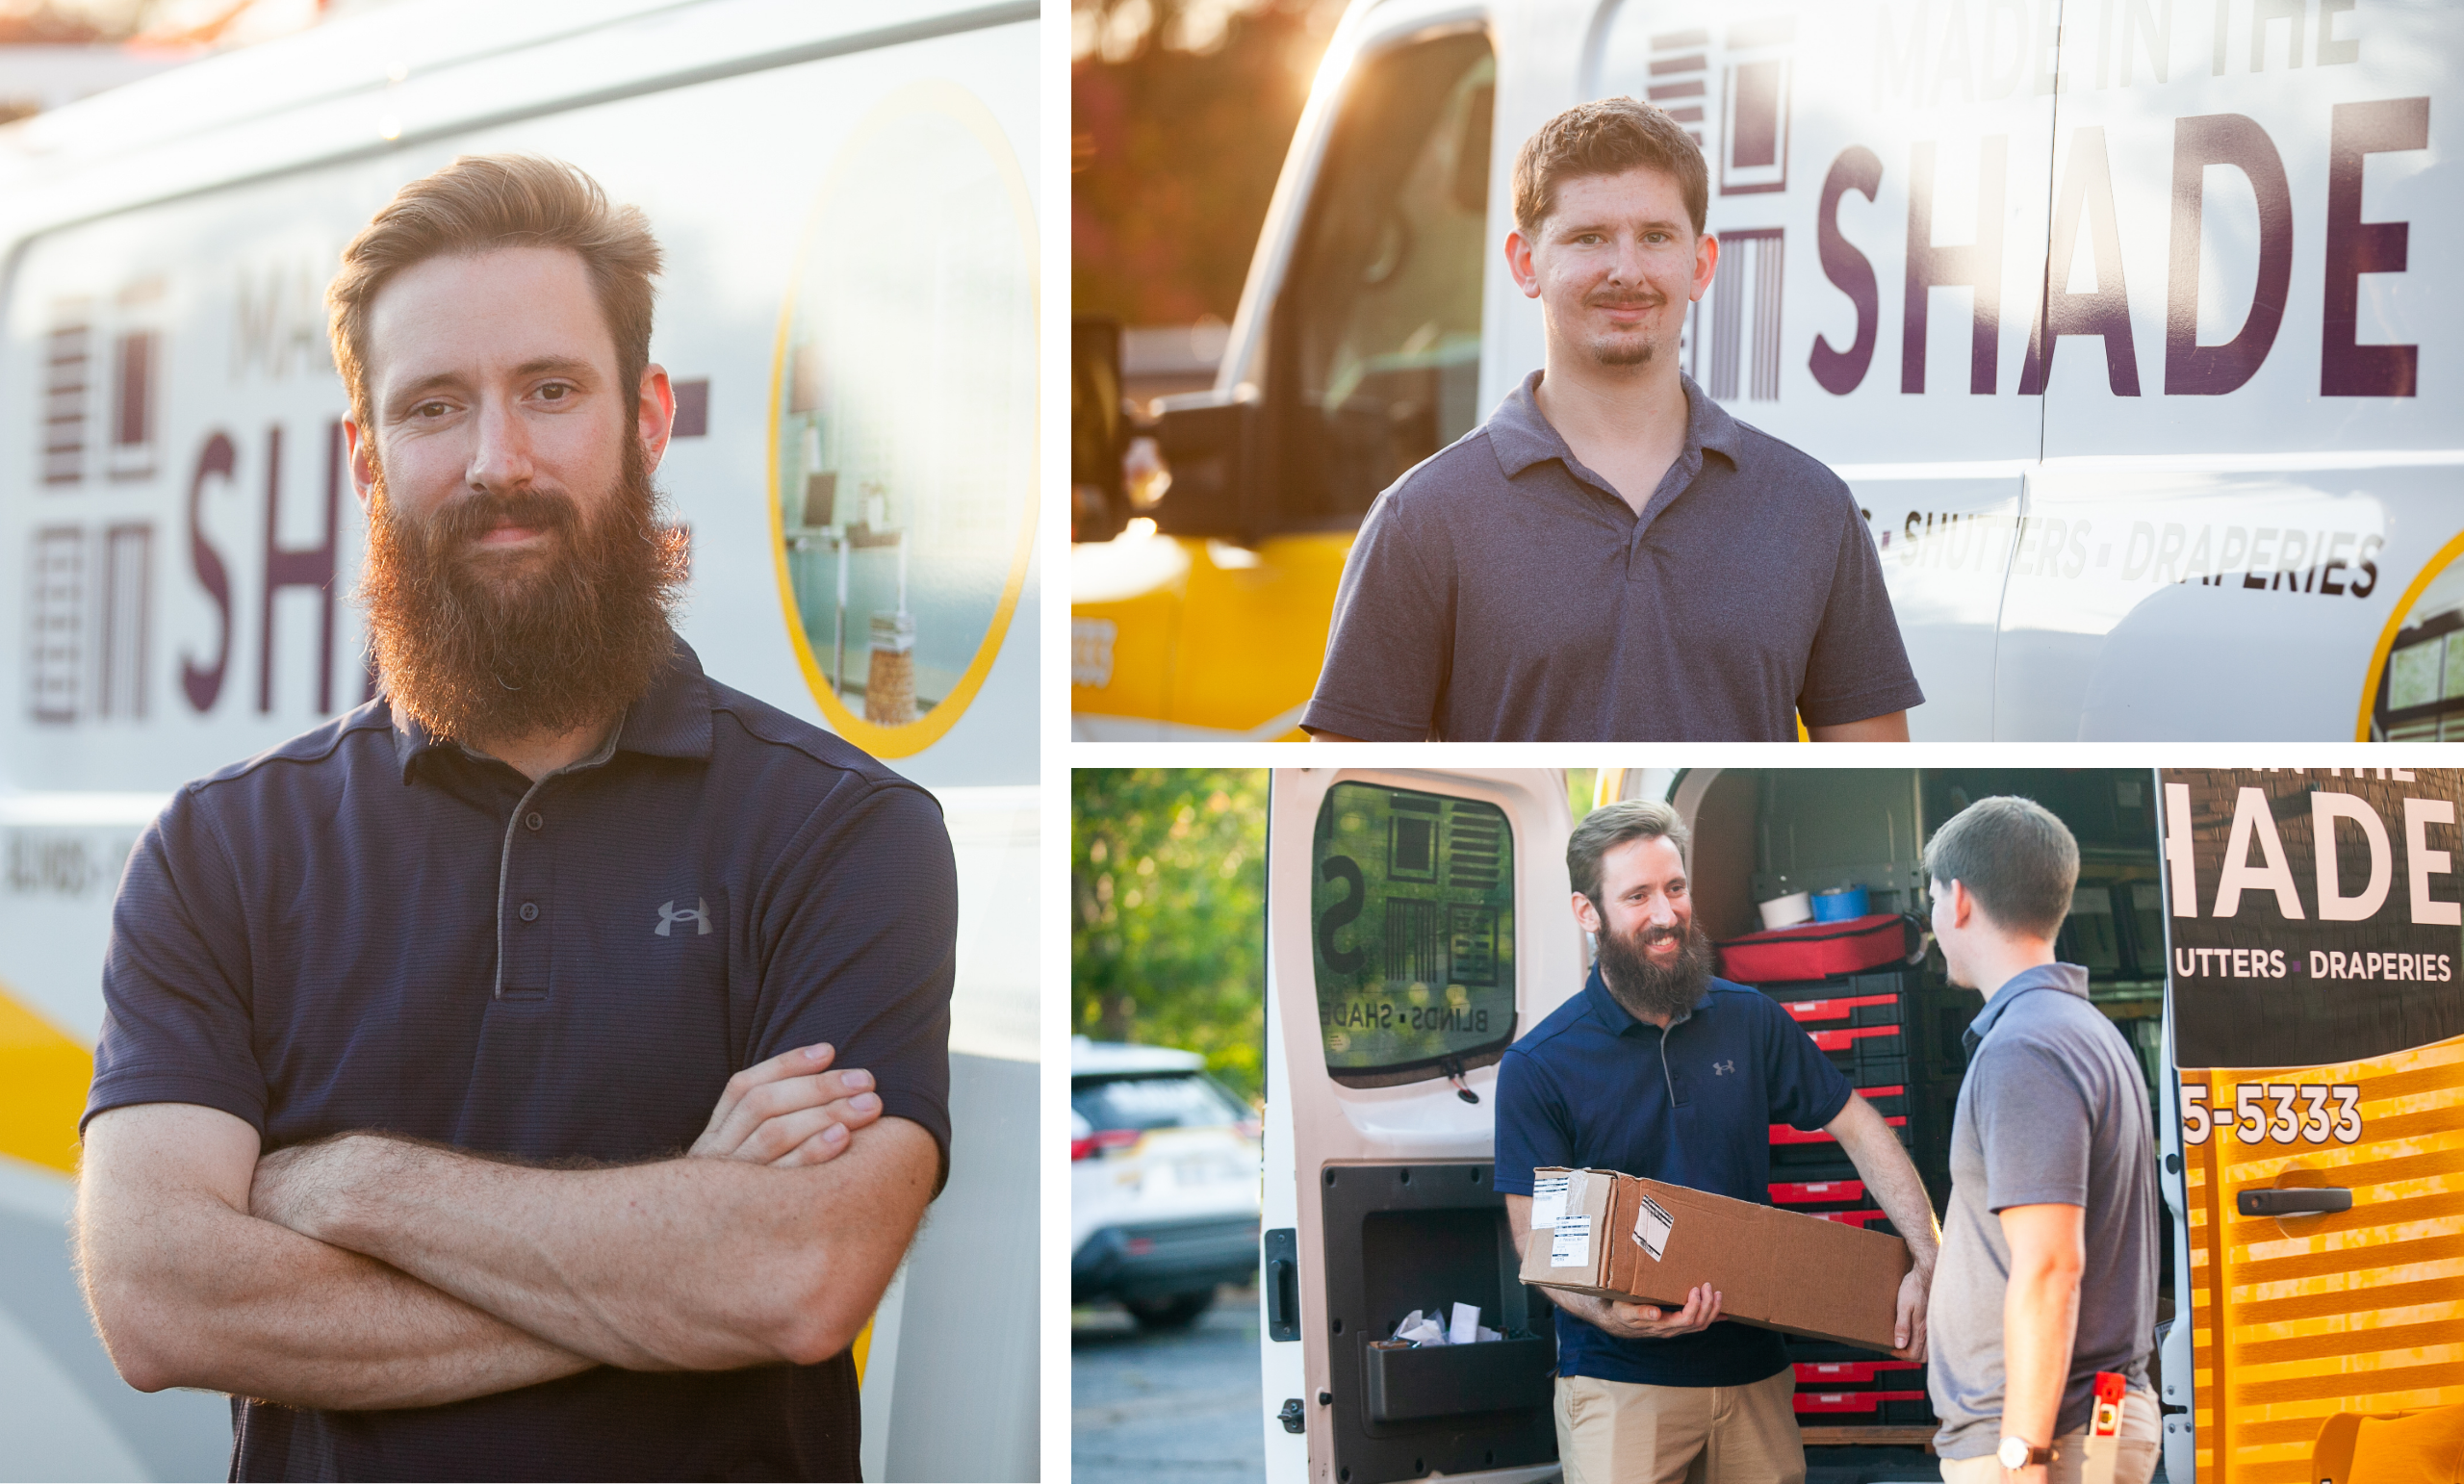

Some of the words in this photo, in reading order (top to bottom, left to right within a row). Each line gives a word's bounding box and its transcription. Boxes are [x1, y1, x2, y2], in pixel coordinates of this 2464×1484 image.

[2095, 0, 2172, 90] IN
[1808, 96, 2430, 397] SHADE
[1900, 509, 2092, 579] SHUTTERS
[2121, 521, 2386, 599] DRAPERIES
[2310, 950, 2451, 982] DRAPERIES
